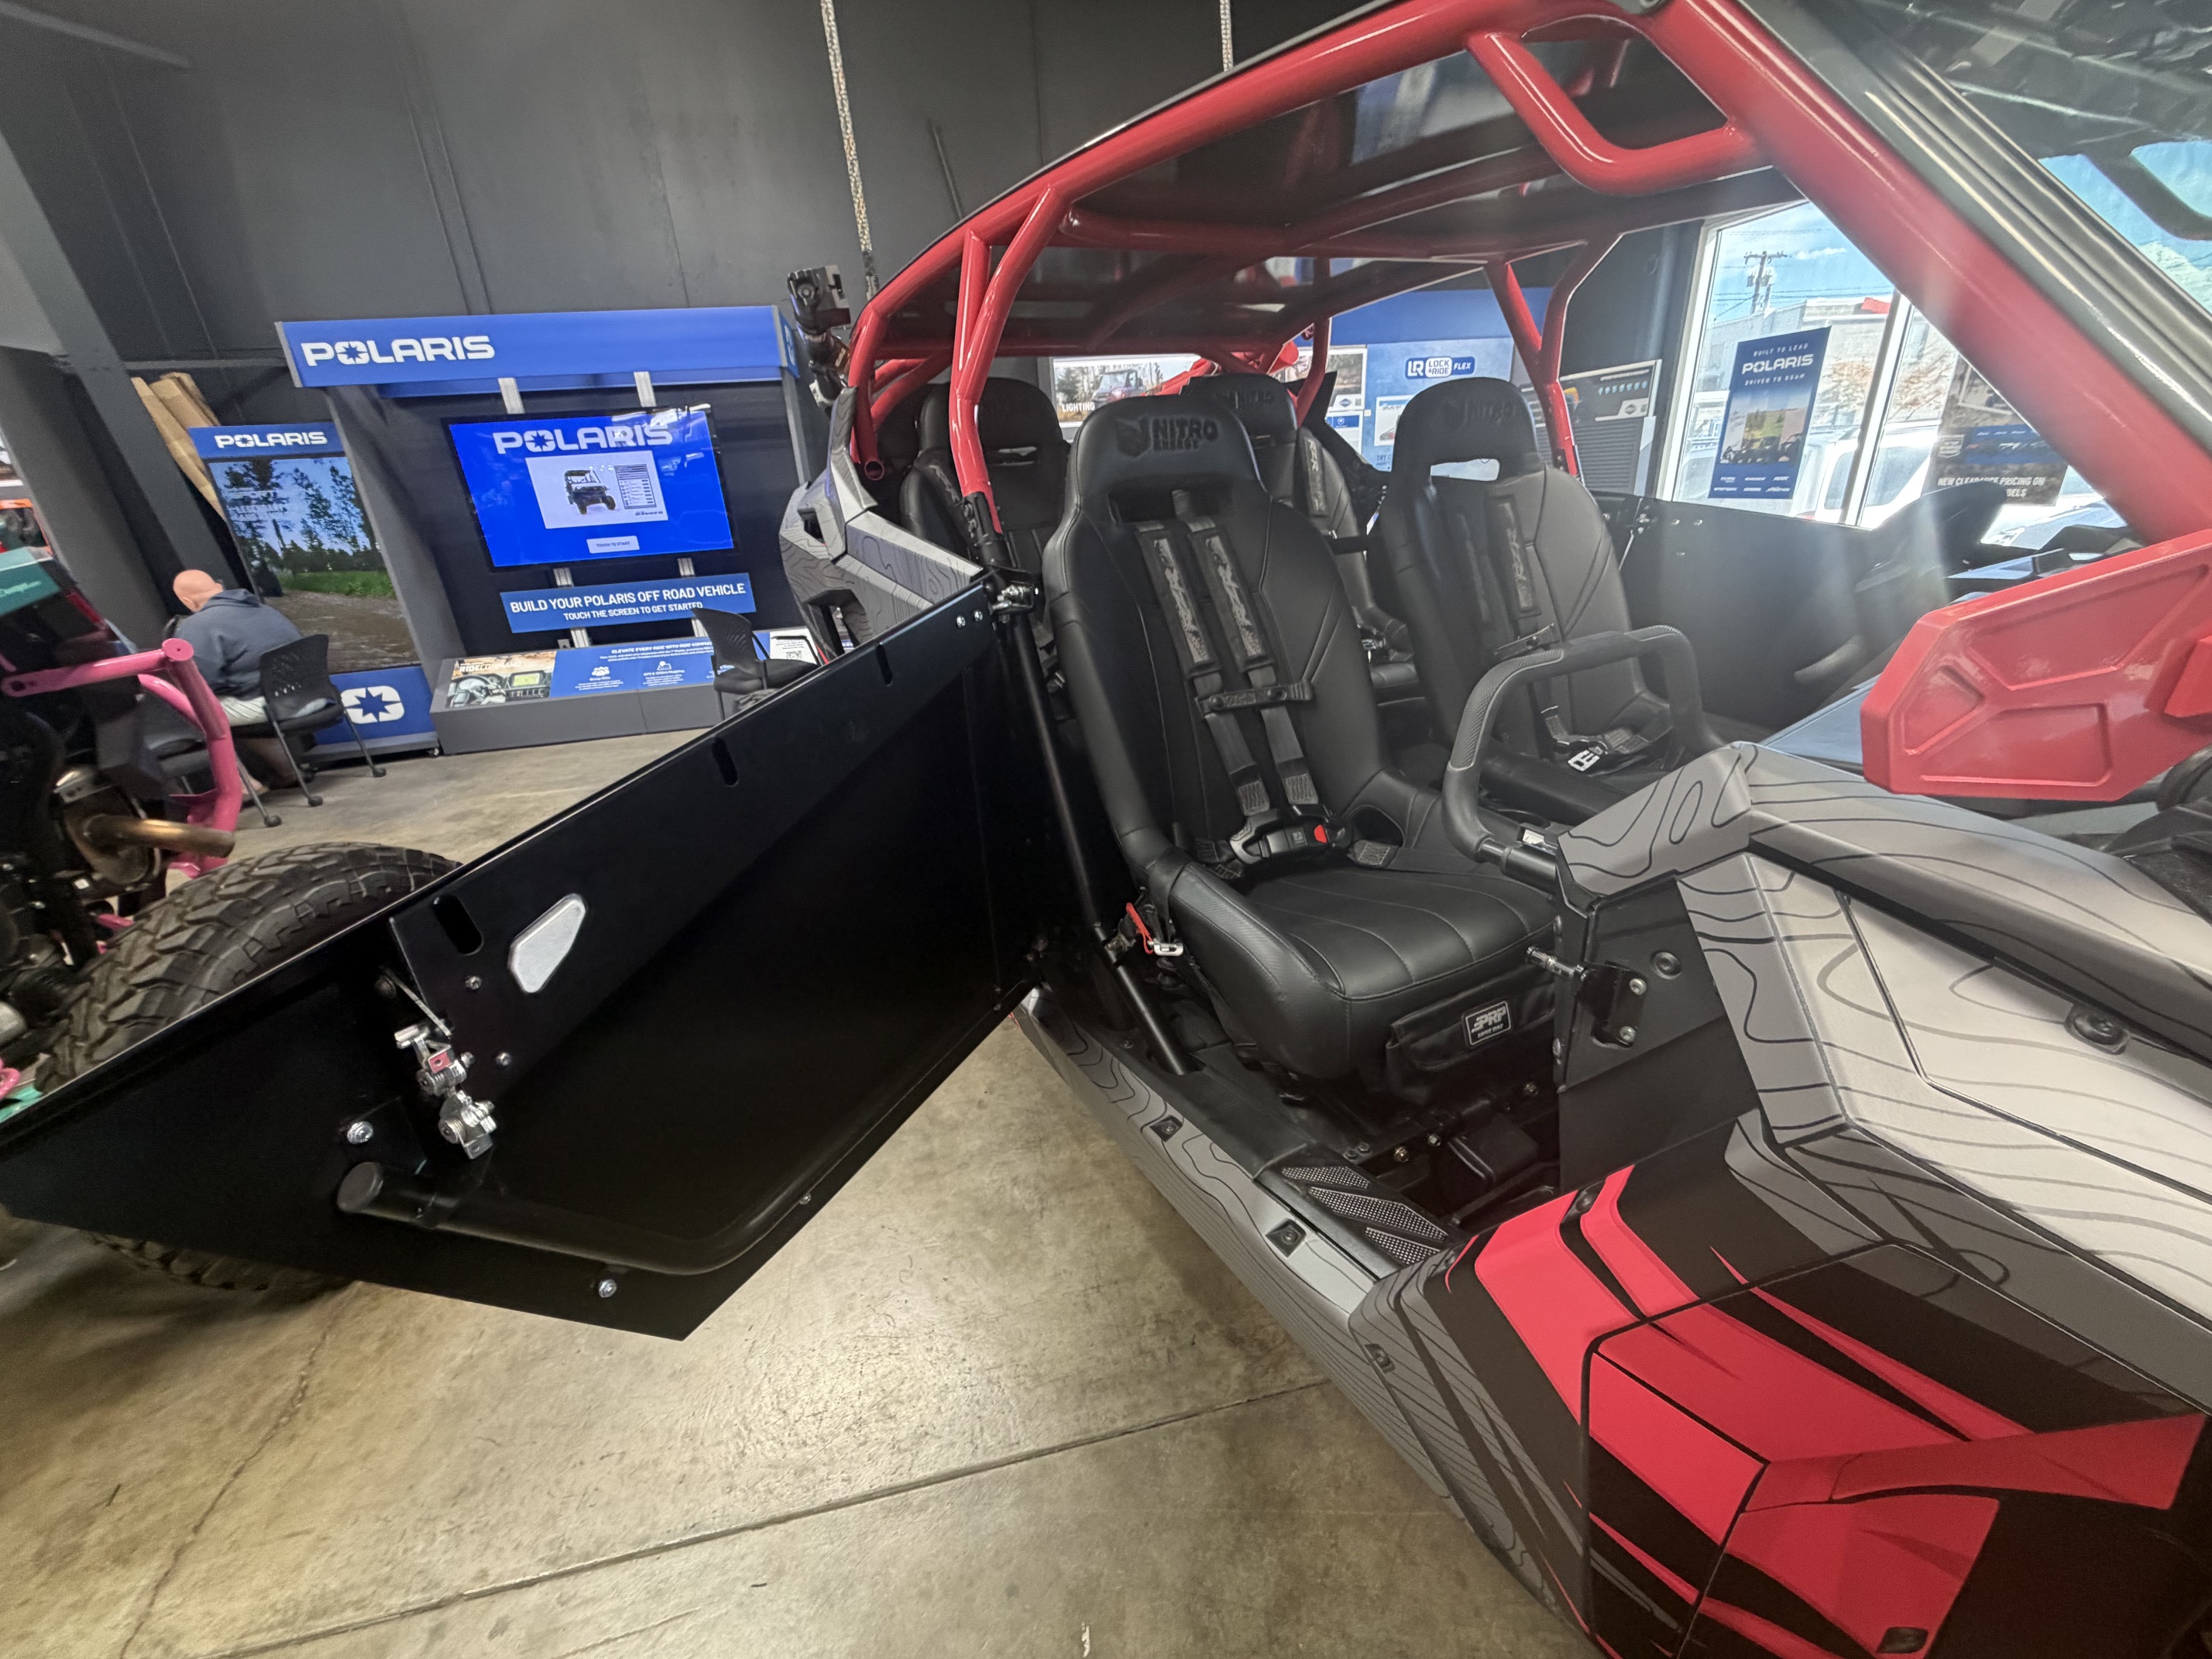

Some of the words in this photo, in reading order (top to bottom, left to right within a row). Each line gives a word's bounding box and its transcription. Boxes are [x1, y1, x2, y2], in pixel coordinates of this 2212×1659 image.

[301, 335, 495, 366] POLARIS
[1753, 348, 1774, 357] BUILT
[1428, 359, 1449, 368] LOCK
[1453, 362, 1472, 370] FLEX
[1741, 353, 1814, 375] POLARIS
[1061, 401, 1096, 413] LIGHTING
[1152, 417, 1219, 441] NITRO
[214, 431, 328, 448] POLARIS
[492, 425, 673, 454] POLARIS
[1937, 476, 1955, 486] NEW
[1999, 476, 2032, 486] PRICING
[2032, 476, 2045, 486] ON
[510, 601, 548, 613] BUILD
[548, 596, 583, 610] YOUR
[584, 592, 637, 607] POLARIS
[637, 589, 661, 603] OFF
[662, 586, 696, 601] ROAD
[696, 583, 746, 597] VEHICLE
[563, 611, 591, 621] TOUCH
[592, 610, 609, 619] THE
[608, 607, 640, 618] SCREEN
[640, 606, 651, 615] TO
[652, 605, 667, 614] GET
